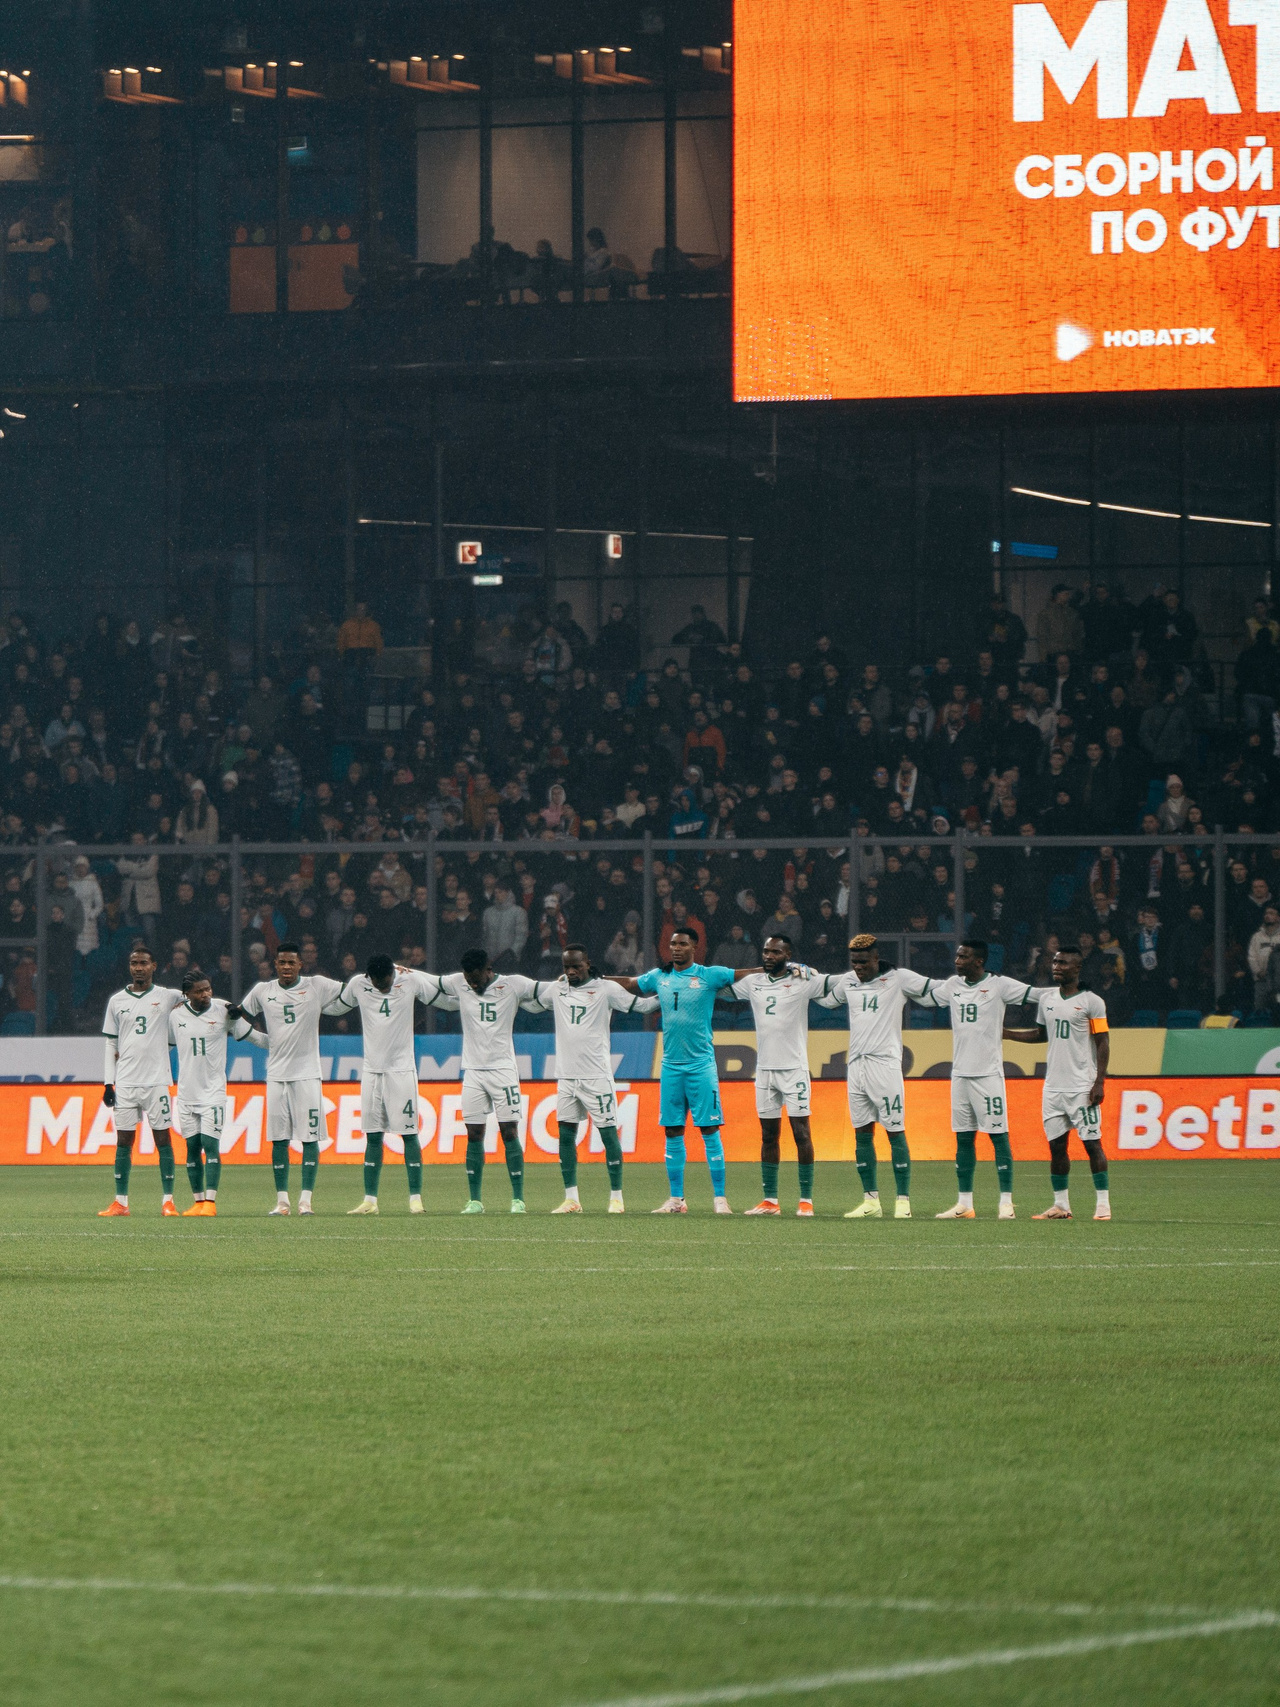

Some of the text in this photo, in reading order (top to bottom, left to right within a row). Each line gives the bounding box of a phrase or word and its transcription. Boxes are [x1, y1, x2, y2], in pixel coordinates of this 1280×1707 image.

[1013, 0, 1280, 122] МАТ
[1014, 136, 1273, 199] СБОРНОЙ
[1091, 204, 1280, 254] ПО ФУТ
[1103, 328, 1216, 347] НОВАТЭК
[379, 998, 391, 1017] 4
[672, 992, 678, 1011] 1
[765, 996, 777, 1015] 2
[862, 993, 880, 1013] 14
[283, 1005, 296, 1024] 5
[479, 1002, 497, 1022] 15
[570, 1005, 587, 1025] 17
[960, 1004, 978, 1023] 19
[135, 1016, 147, 1034] 3
[1055, 1018, 1070, 1039] 10
[190, 1037, 206, 1056] 11
[503, 1085, 520, 1106] 15
[711, 1090, 718, 1110] 1
[796, 1081, 808, 1100] 2
[160, 1095, 170, 1115] 3
[402, 1099, 415, 1118] 4
[596, 1093, 614, 1114] 17
[882, 1094, 902, 1116] 14
[984, 1096, 1004, 1116] 19
[26, 1095, 265, 1154] МАИ
[212, 1106, 224, 1126] 11
[308, 1109, 319, 1128] 5
[1079, 1106, 1098, 1126] 10
[1118, 1088, 1280, 1151] BetB
